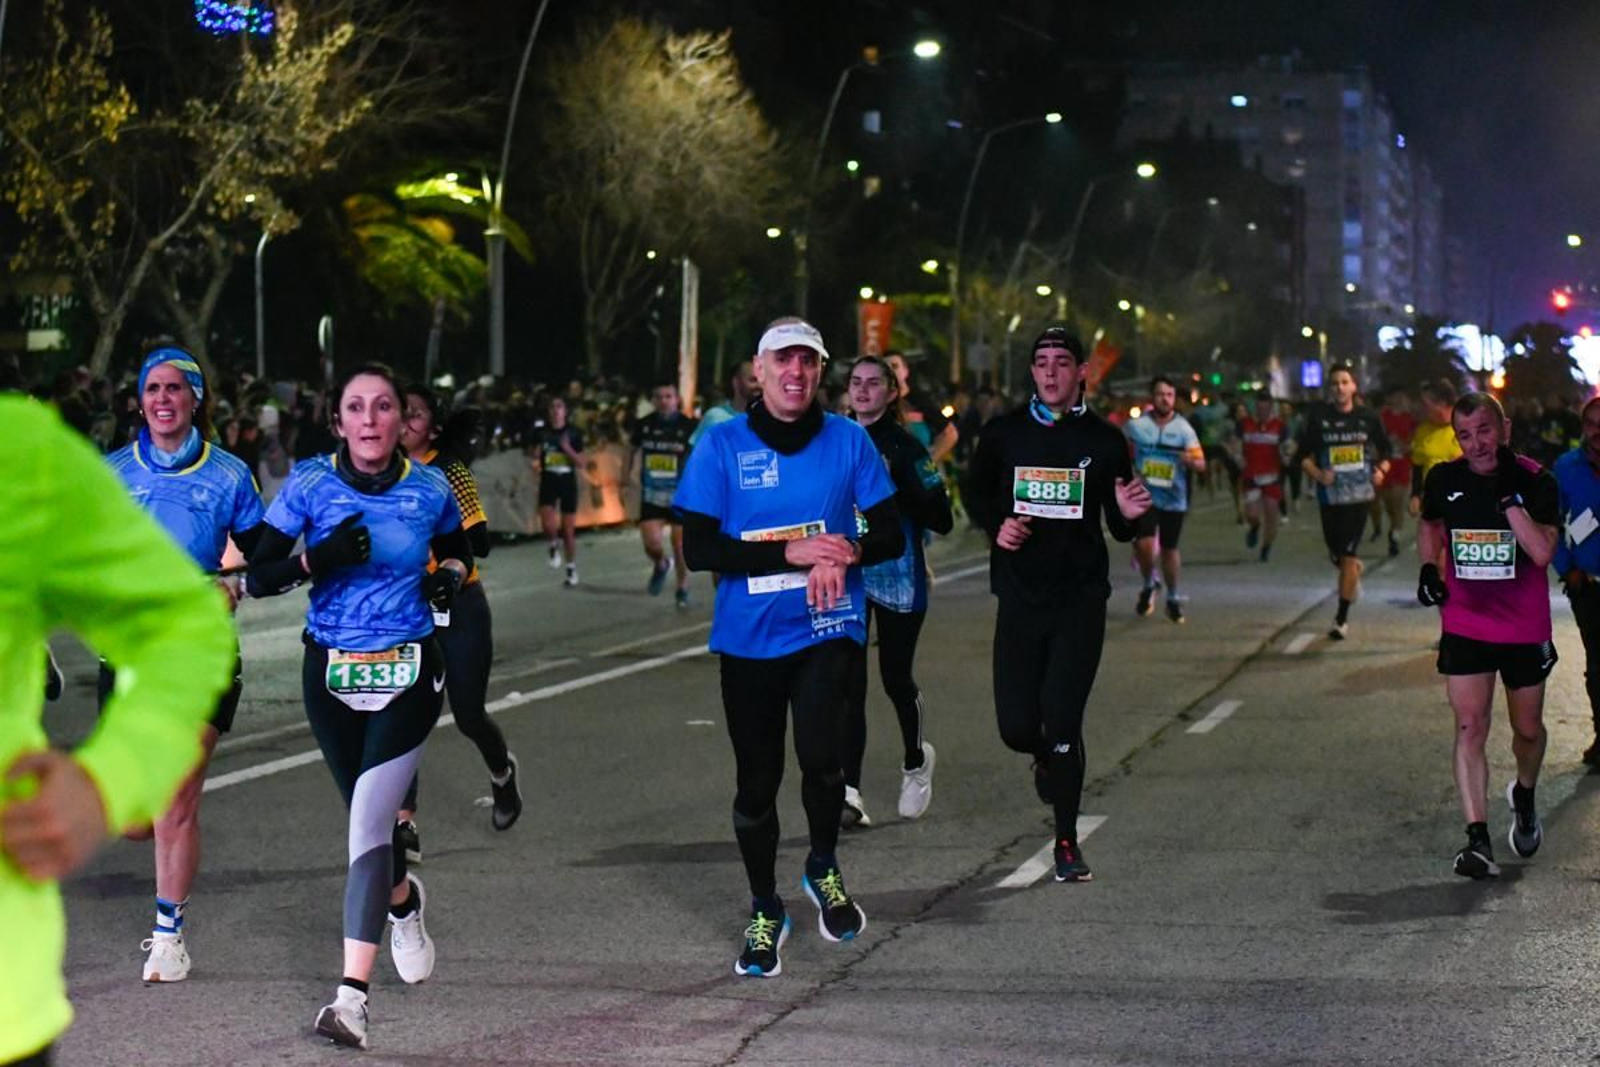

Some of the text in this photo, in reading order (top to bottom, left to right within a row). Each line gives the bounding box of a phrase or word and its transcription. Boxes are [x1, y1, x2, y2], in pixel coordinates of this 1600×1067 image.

[1027, 481, 1070, 500] 888
[1457, 543, 1510, 562] 2905
[335, 663, 411, 687] 1338
